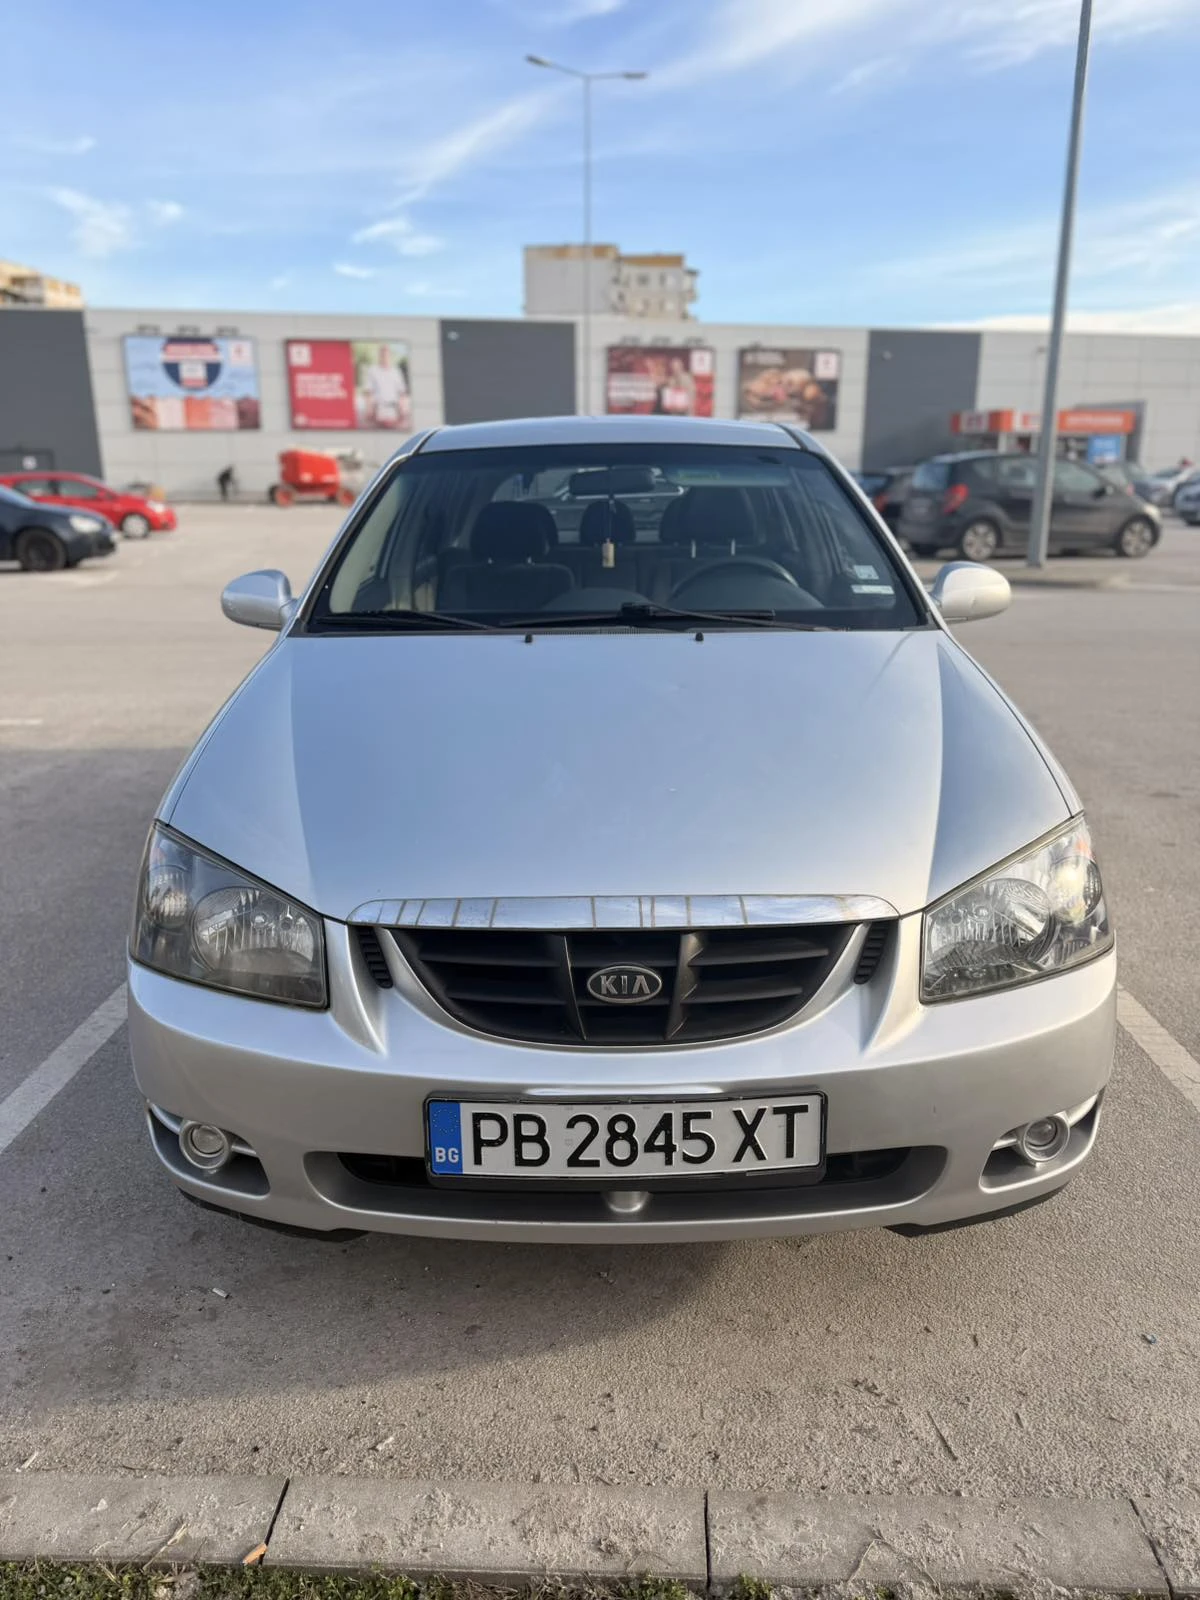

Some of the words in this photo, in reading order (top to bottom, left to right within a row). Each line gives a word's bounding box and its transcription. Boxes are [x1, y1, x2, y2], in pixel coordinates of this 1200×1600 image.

[600, 975, 651, 995] KIA
[471, 1111, 551, 1167] PB
[565, 1110, 716, 1168] 2845
[731, 1104, 810, 1163] XT
[434, 1146, 460, 1164] BG
